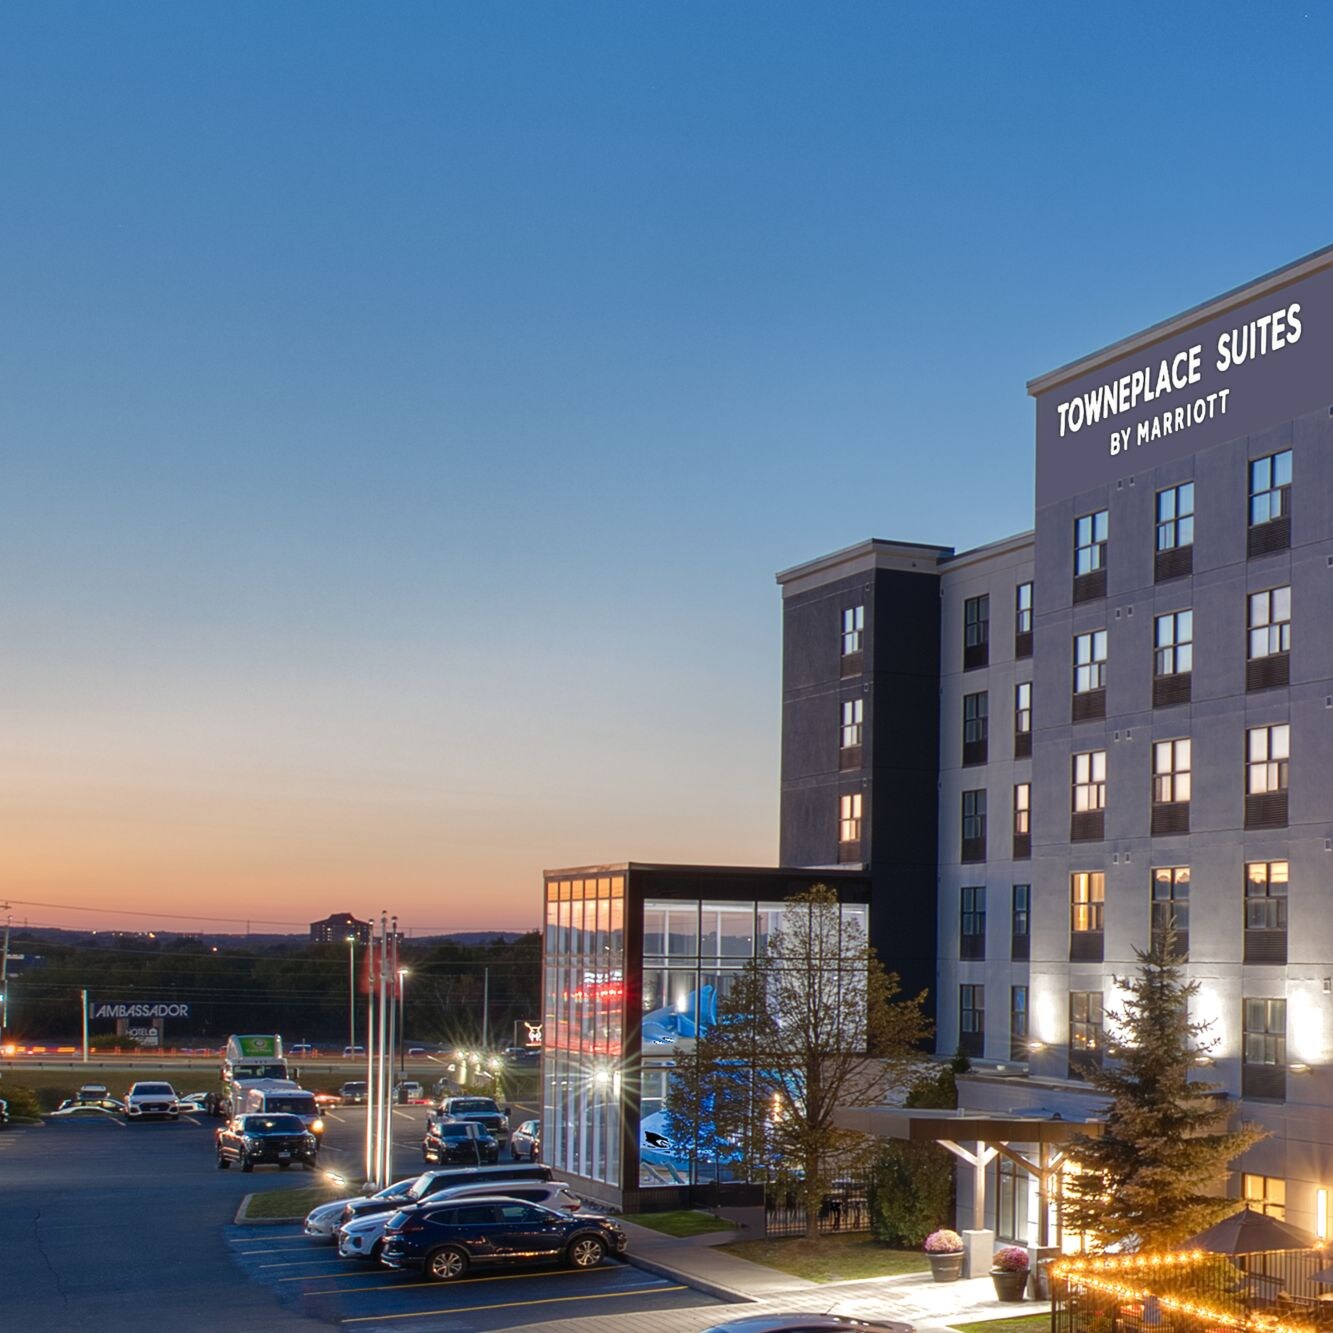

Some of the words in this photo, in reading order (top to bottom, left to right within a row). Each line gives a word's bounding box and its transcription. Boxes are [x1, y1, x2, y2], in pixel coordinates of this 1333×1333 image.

[1057, 344, 1202, 437] TOWNEPLACE
[1216, 303, 1302, 372] SUITES
[1110, 427, 1131, 456] BY
[1137, 388, 1230, 446] MARRIOTT
[95, 1004, 189, 1018] AMBASSADOR
